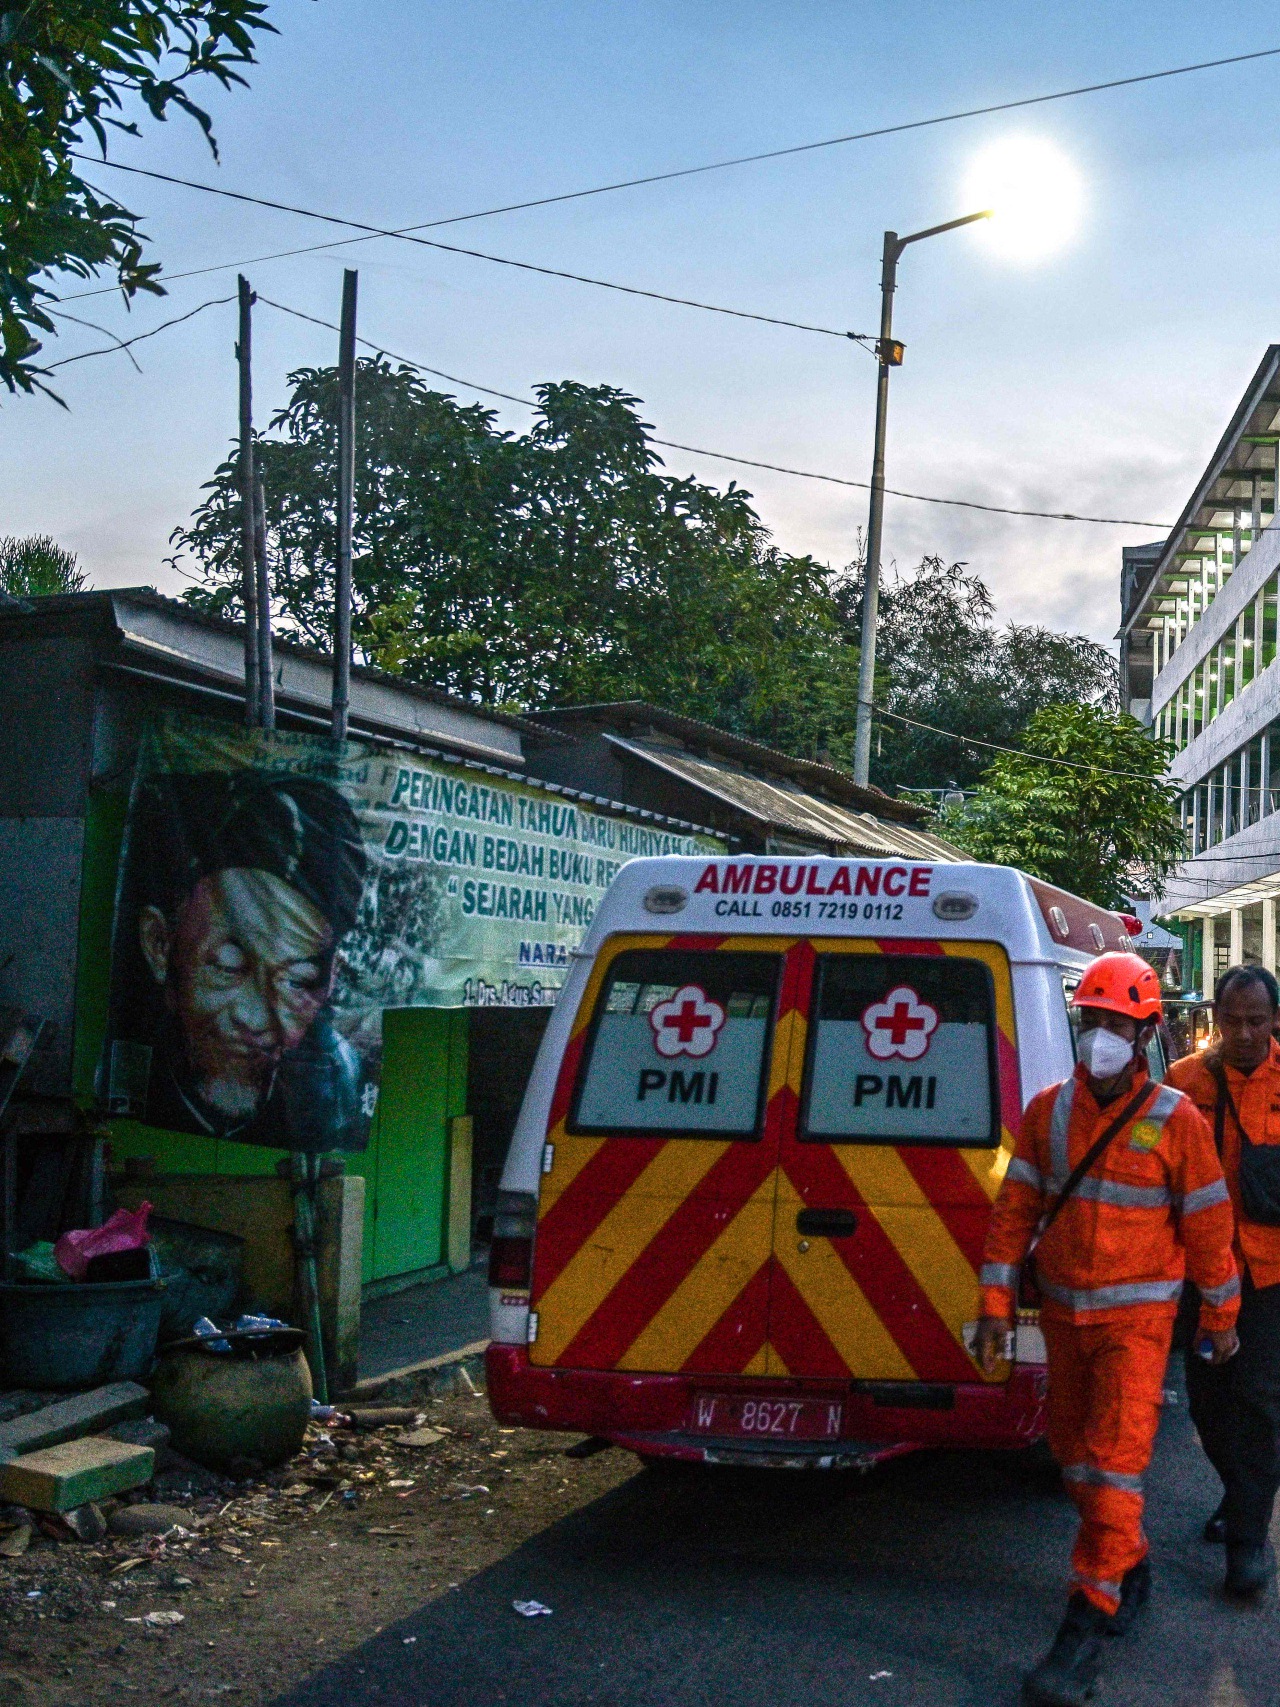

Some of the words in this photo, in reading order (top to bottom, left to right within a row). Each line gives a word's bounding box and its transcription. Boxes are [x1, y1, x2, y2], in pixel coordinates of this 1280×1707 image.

[391, 769, 513, 827] PERINGATAN
[519, 797, 578, 840] TAHUN
[385, 820, 477, 866] DENGAN
[483, 835, 544, 878] BEDAH
[549, 848, 593, 886] BUKU
[694, 863, 934, 898] AMBULANCE
[462, 880, 548, 922] SEJARAH
[552, 892, 594, 927] YANG
[715, 900, 763, 918] CALL
[771, 901, 810, 919] 0851
[818, 902, 857, 920] 7219
[863, 903, 903, 921] 0112
[636, 1068, 719, 1105] PMI
[853, 1073, 938, 1109] PMI
[698, 1400, 717, 1427] W
[741, 1401, 804, 1432] 8627
[827, 1404, 843, 1434] N
